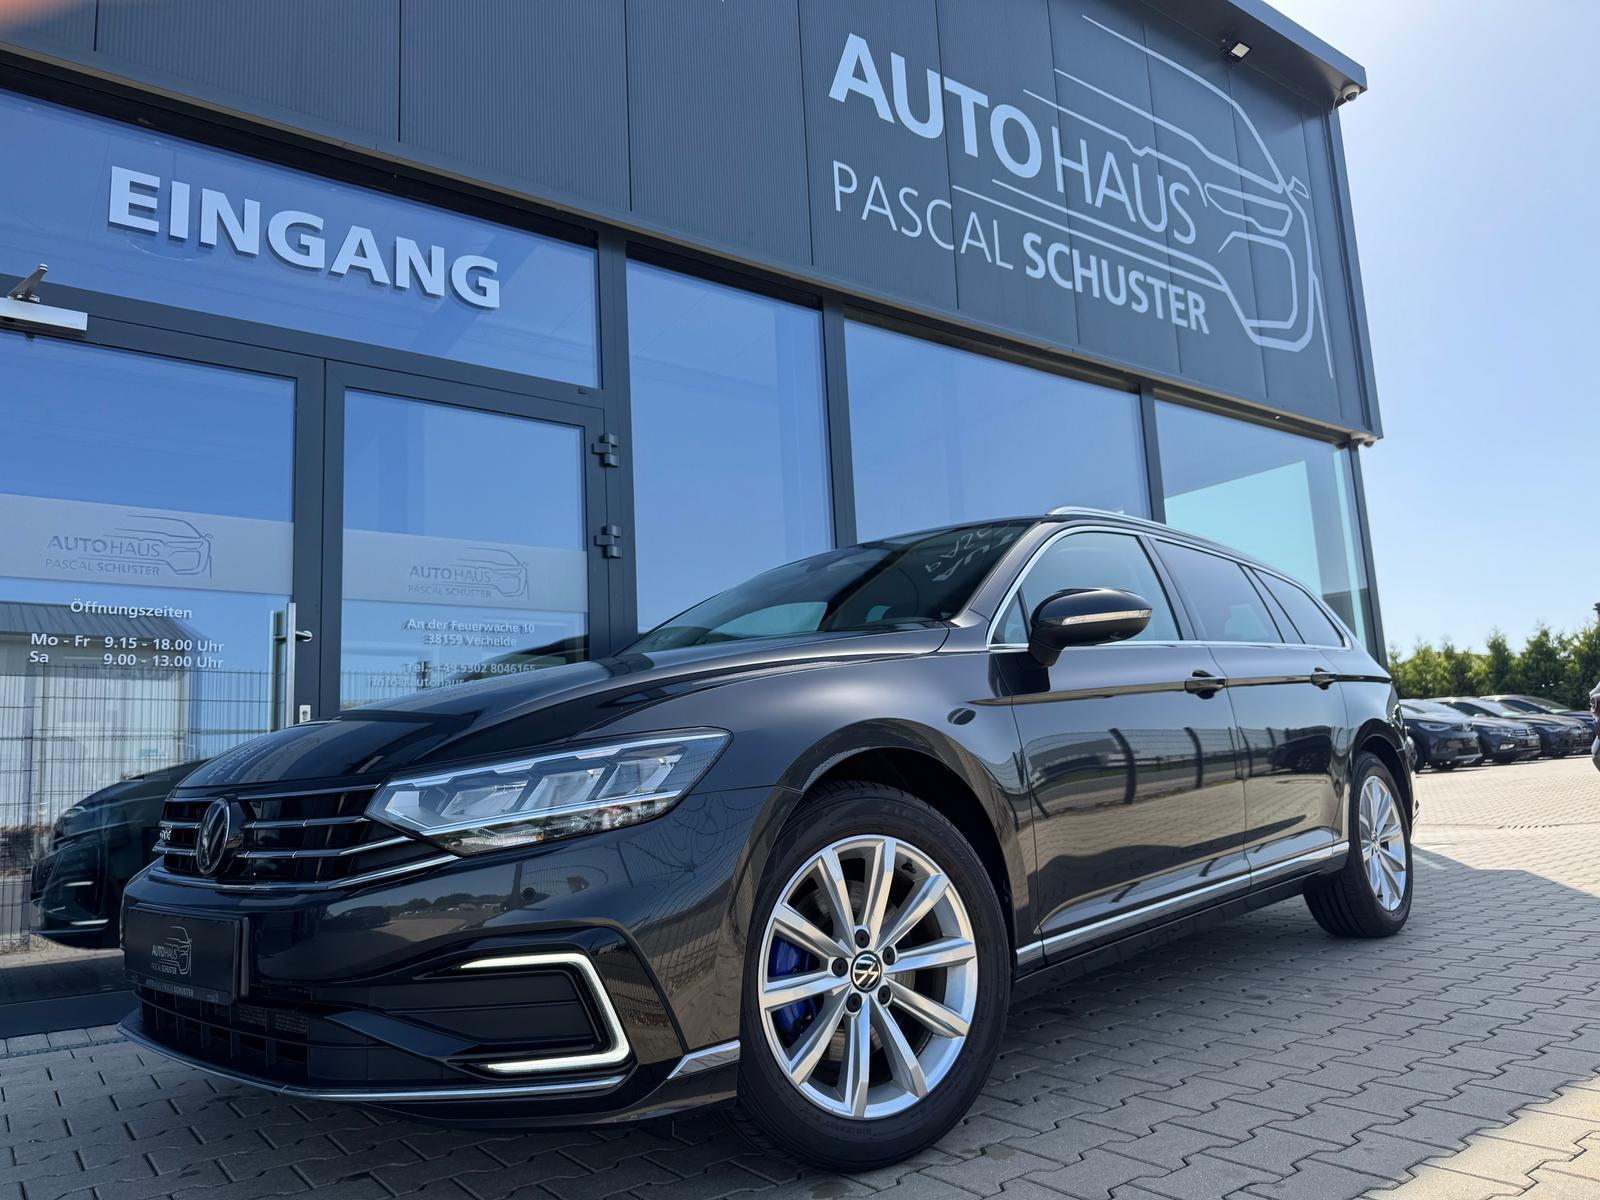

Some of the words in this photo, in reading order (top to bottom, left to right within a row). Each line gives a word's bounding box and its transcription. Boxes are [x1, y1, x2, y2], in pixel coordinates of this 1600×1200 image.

[829, 32, 1197, 245] AUTOHAUS
[108, 165, 500, 308] EINGANG
[832, 159, 1013, 270] PASCAL
[1022, 232, 1210, 335] SCHUSTER
[48, 535, 160, 558] AUTOHAUS
[45, 558, 95, 572] PASCAL
[96, 561, 160, 576] SCHUSTER
[410, 565, 492, 583] AUTOHAUS
[70, 598, 192, 619] Öffnungszeiten
[408, 618, 425, 629] An
[428, 619, 448, 631] der
[452, 620, 519, 632] Feuerwache
[523, 623, 535, 633] 10
[30, 632, 59, 646] Mo
[75, 635, 91, 648] Fr
[104, 636, 138, 649] 9.15
[152, 638, 193, 652] 18.00
[197, 640, 225, 653] Uhr
[467, 634, 517, 646] Vechelde
[29, 650, 50, 664] Sa
[103, 653, 137, 666] 9.00
[152, 655, 193, 668] 13.00
[196, 656, 224, 669] Uhr
